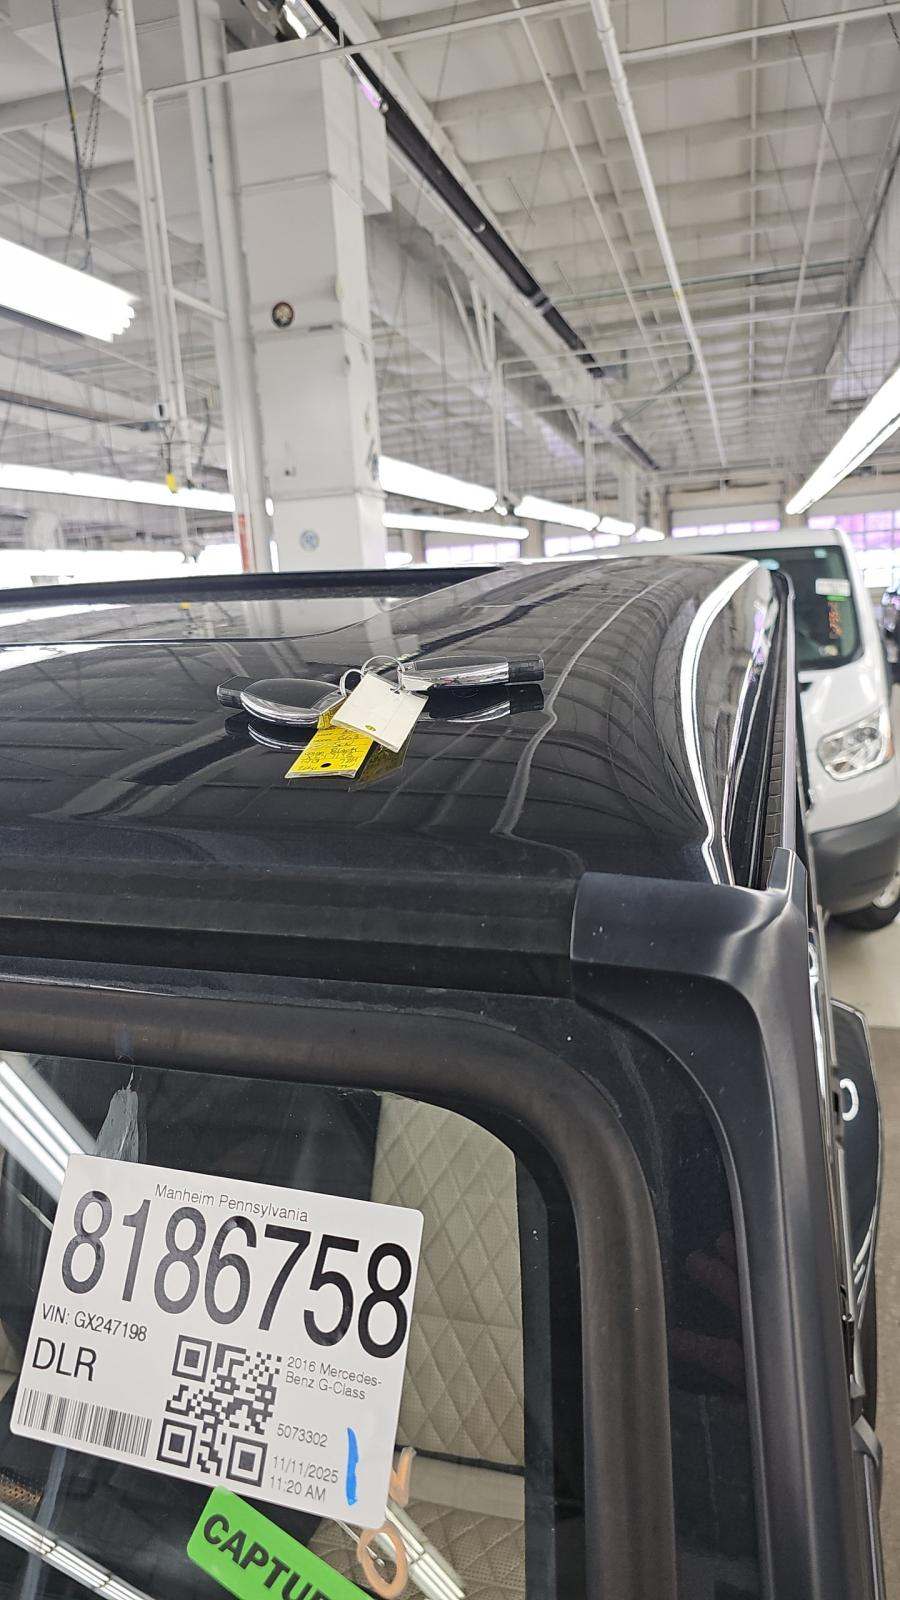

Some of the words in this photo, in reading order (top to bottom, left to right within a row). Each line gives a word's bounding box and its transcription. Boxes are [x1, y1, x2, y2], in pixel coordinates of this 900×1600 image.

[155, 1183, 215, 1206] Manheim
[218, 1194, 309, 1222] Pennsylvania
[61, 1190, 412, 1359] 8186758
[42, 1303, 70, 1326] VIN:
[74, 1310, 148, 1342] GX247198
[32, 1337, 97, 1381] DLR
[287, 1356, 317, 1372] 2016
[319, 1362, 382, 1387] Mercedes-
[285, 1370, 315, 1388] Benz
[318, 1378, 366, 1400] G-Class
[276, 1423, 328, 1448] 5073302
[273, 1456, 339, 1484] 11/11/2025
[270, 1475, 302, 1495] 11:20
[305, 1485, 327, 1505] AM
[203, 1513, 332, 1600] CAPTU
